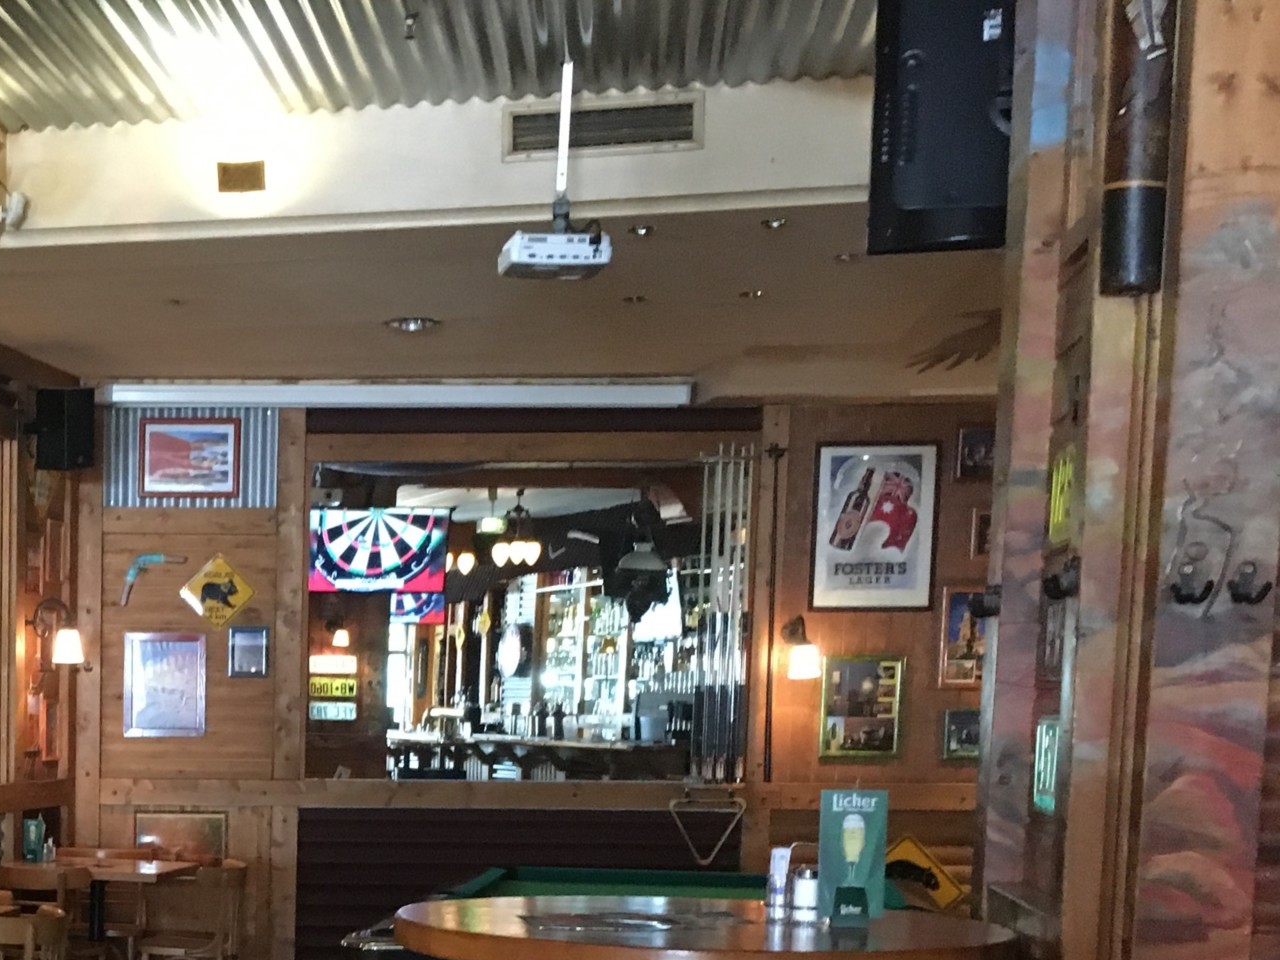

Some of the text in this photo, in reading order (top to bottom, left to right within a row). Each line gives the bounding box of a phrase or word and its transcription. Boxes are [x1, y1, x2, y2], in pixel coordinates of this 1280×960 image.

[834, 561, 908, 576] FOSTER'S
[848, 575, 891, 586] LAGER
[832, 792, 879, 811] Licher
